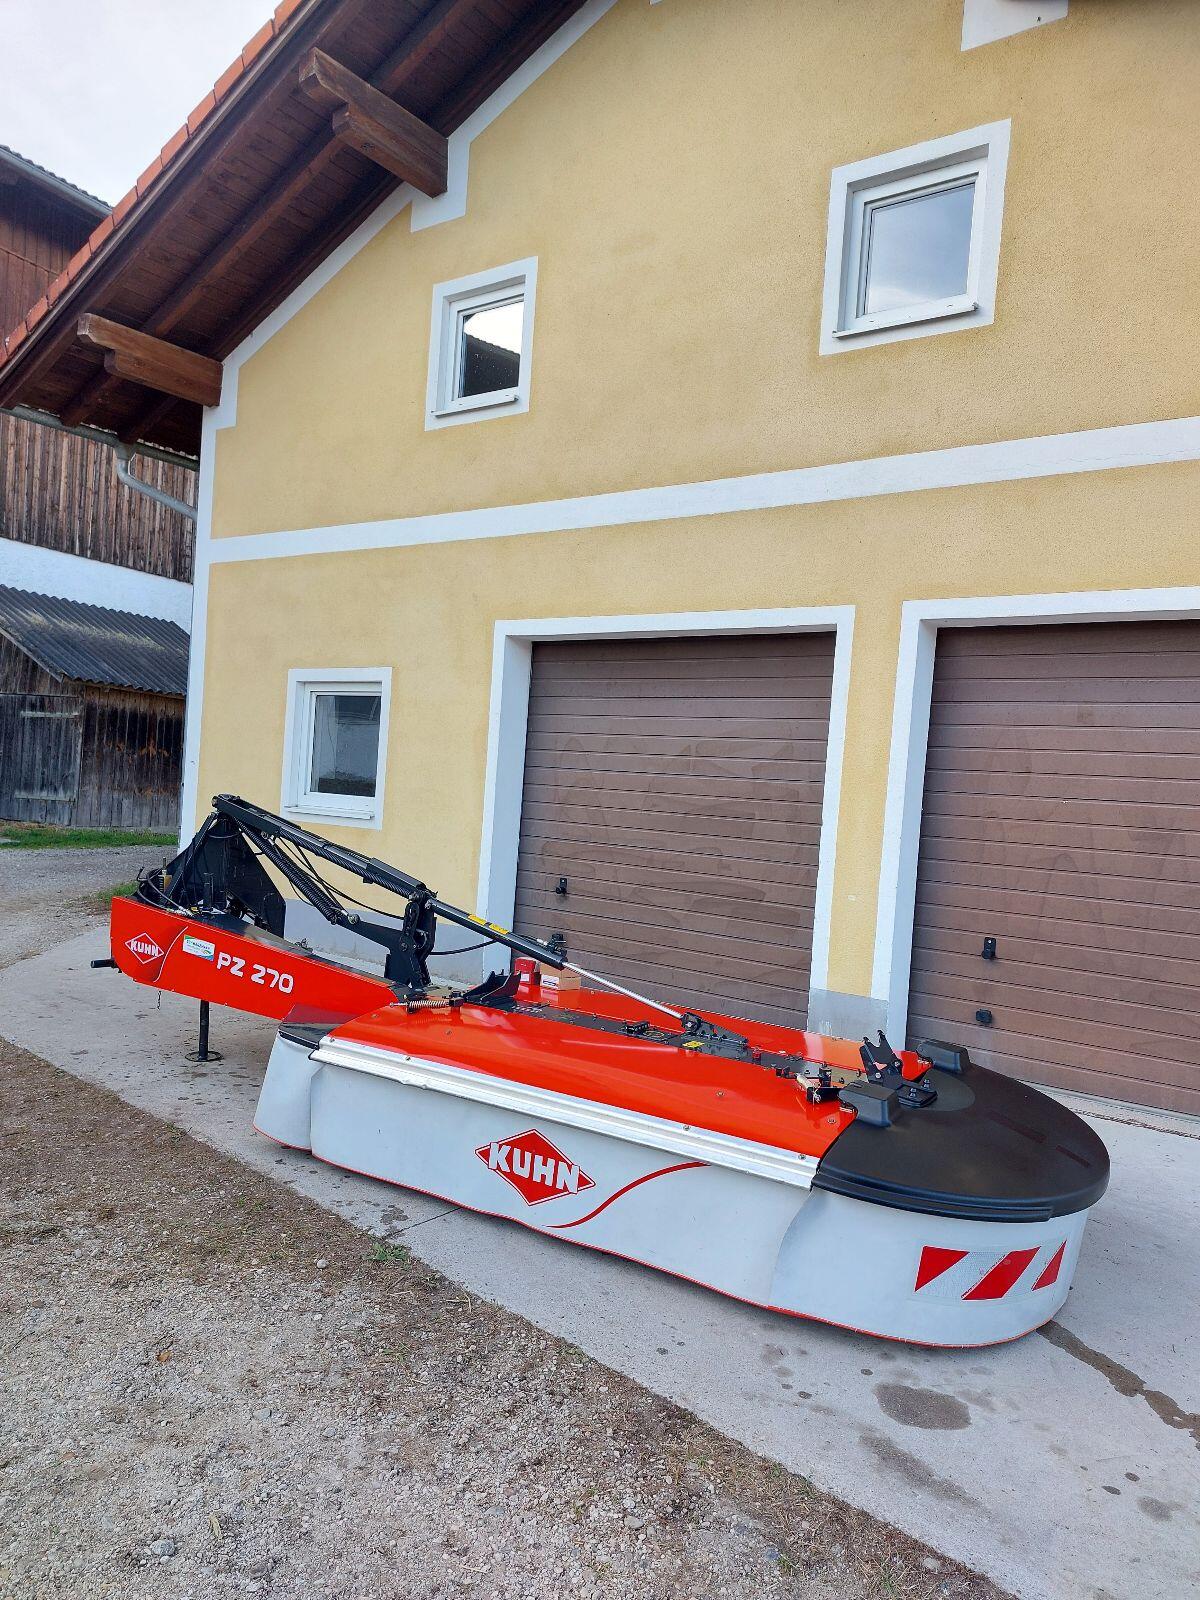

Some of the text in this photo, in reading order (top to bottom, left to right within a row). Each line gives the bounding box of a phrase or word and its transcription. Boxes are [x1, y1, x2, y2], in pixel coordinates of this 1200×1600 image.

[130, 940, 159, 957] KUHN
[216, 952, 294, 993] PZ 270
[488, 1142, 580, 1194] KUHN
